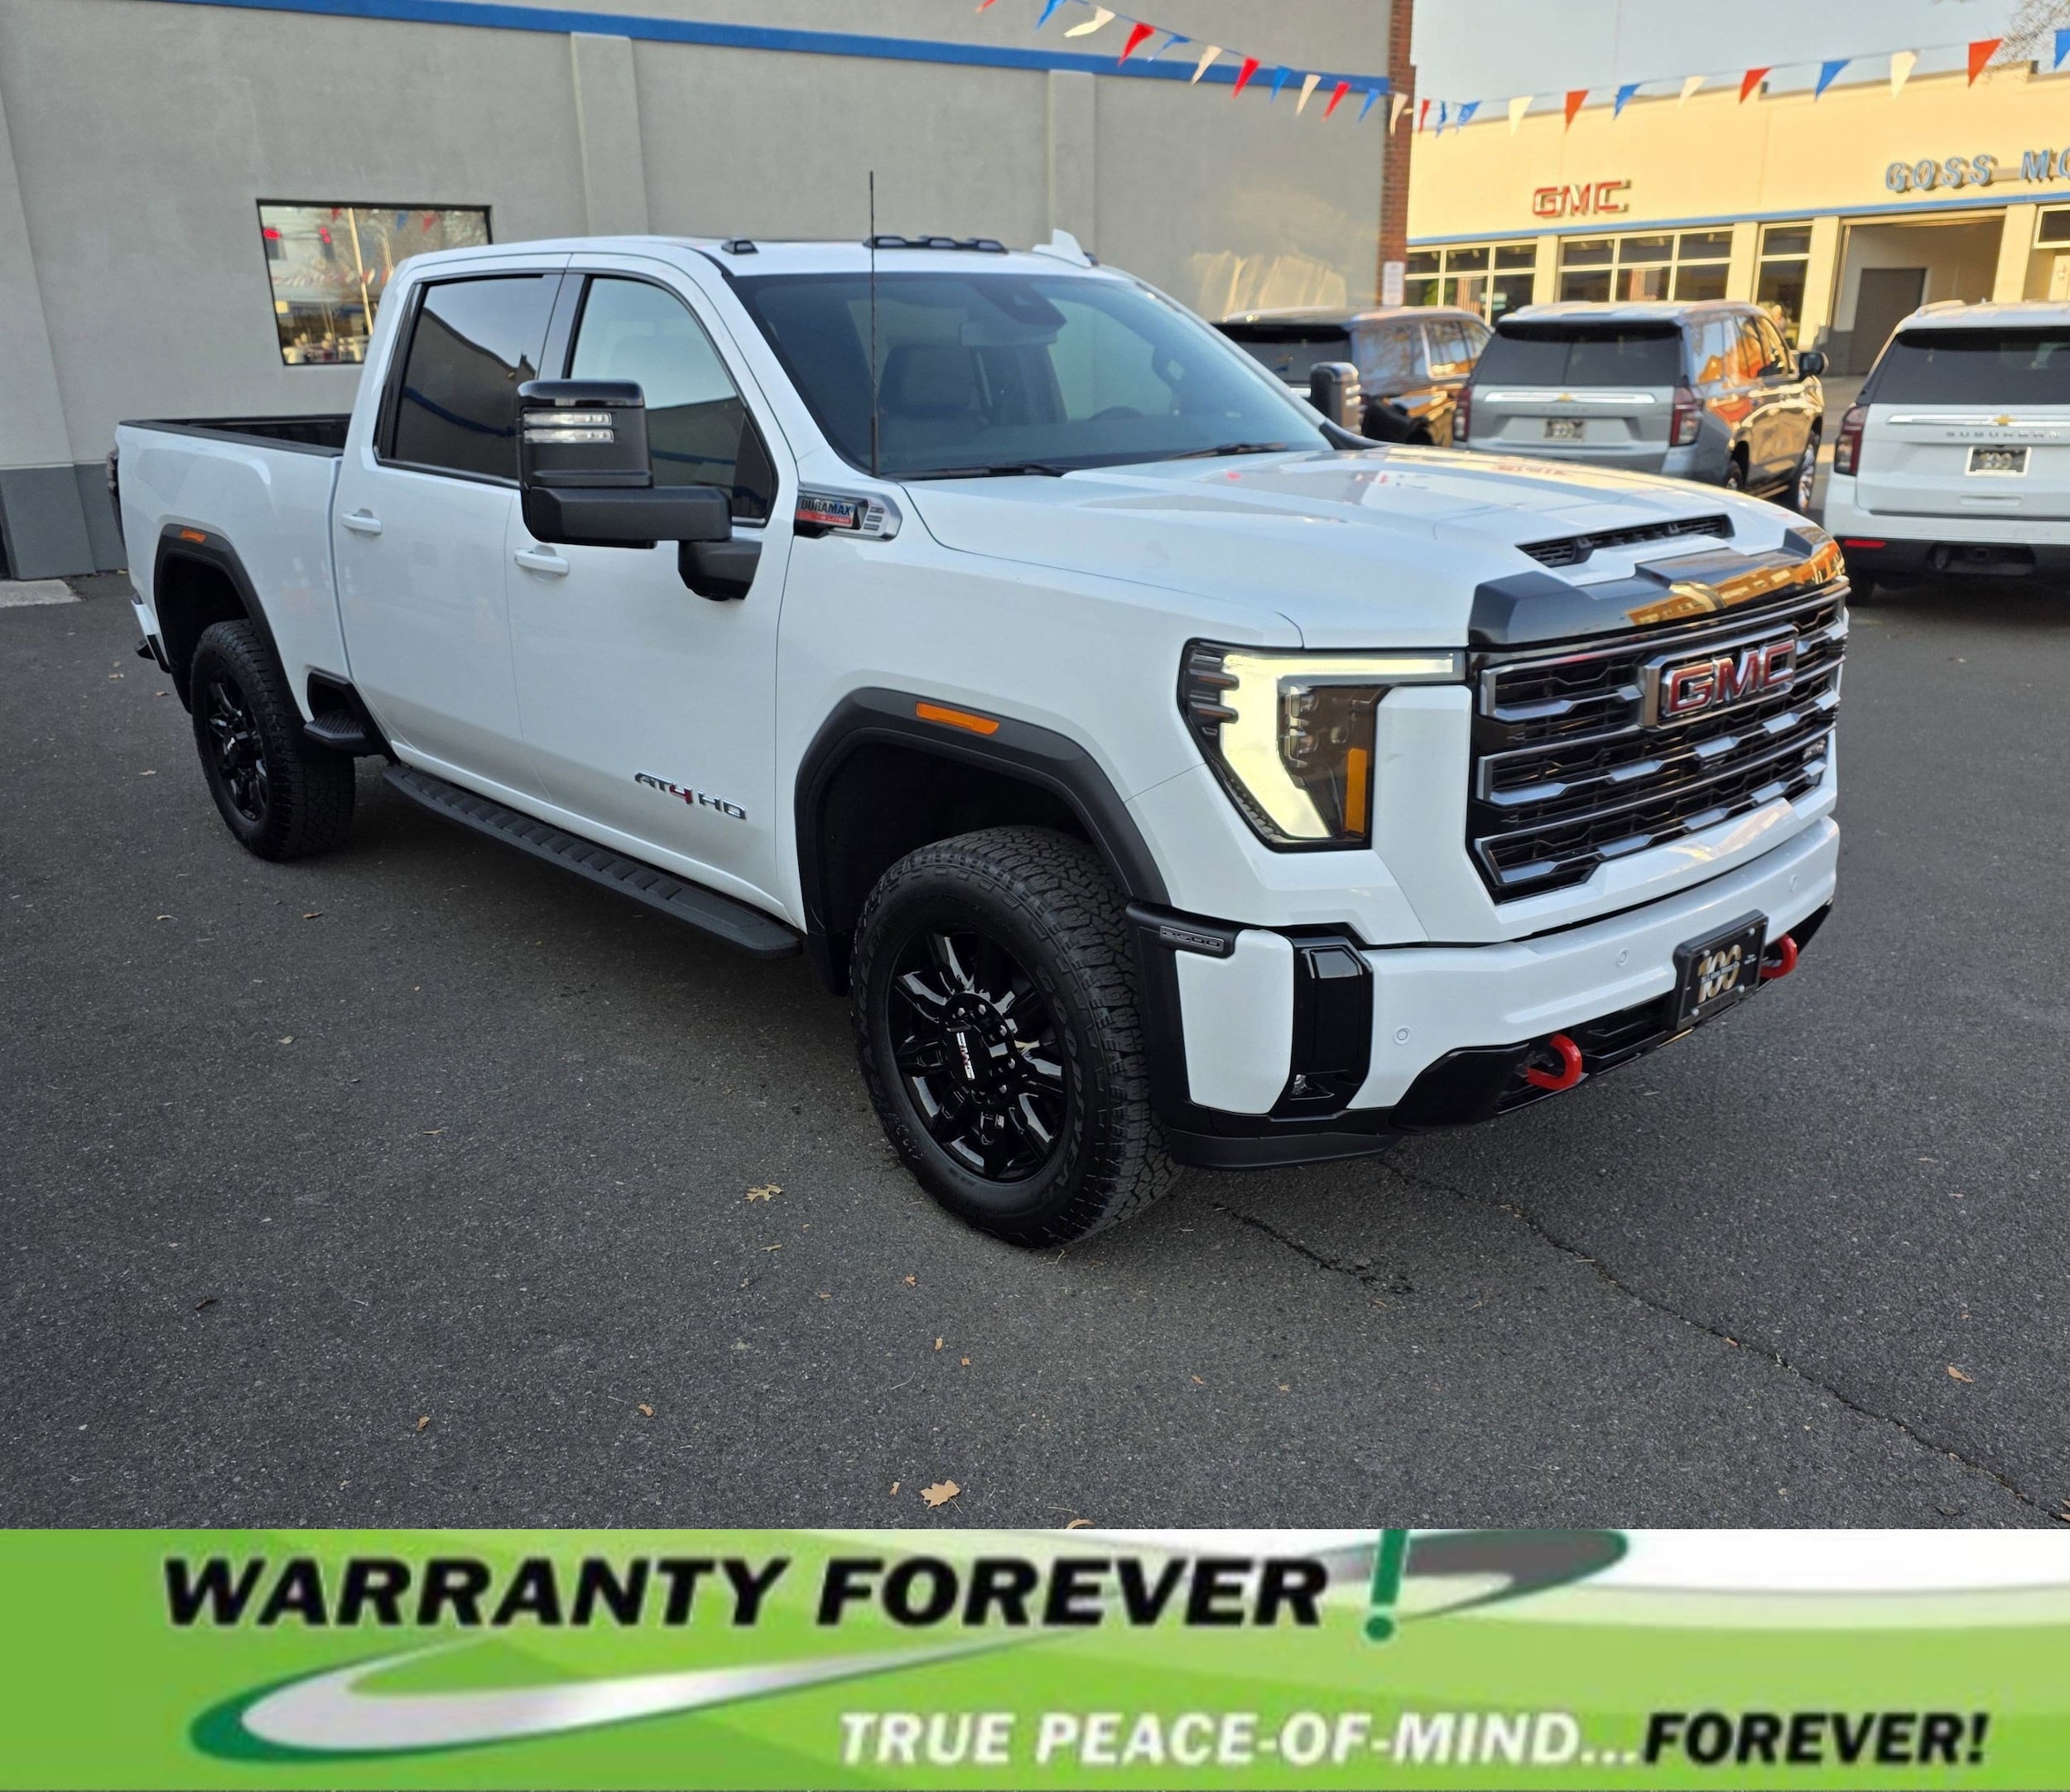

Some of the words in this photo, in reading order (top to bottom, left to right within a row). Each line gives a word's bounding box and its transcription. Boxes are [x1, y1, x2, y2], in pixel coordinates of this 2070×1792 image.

[1885, 153, 1997, 192] GOSS
[1532, 180, 1631, 217] GMC
[801, 498, 852, 516] DURAMAX
[1661, 639, 1795, 717] GMC
[1162, 930, 1220, 947] 2500
